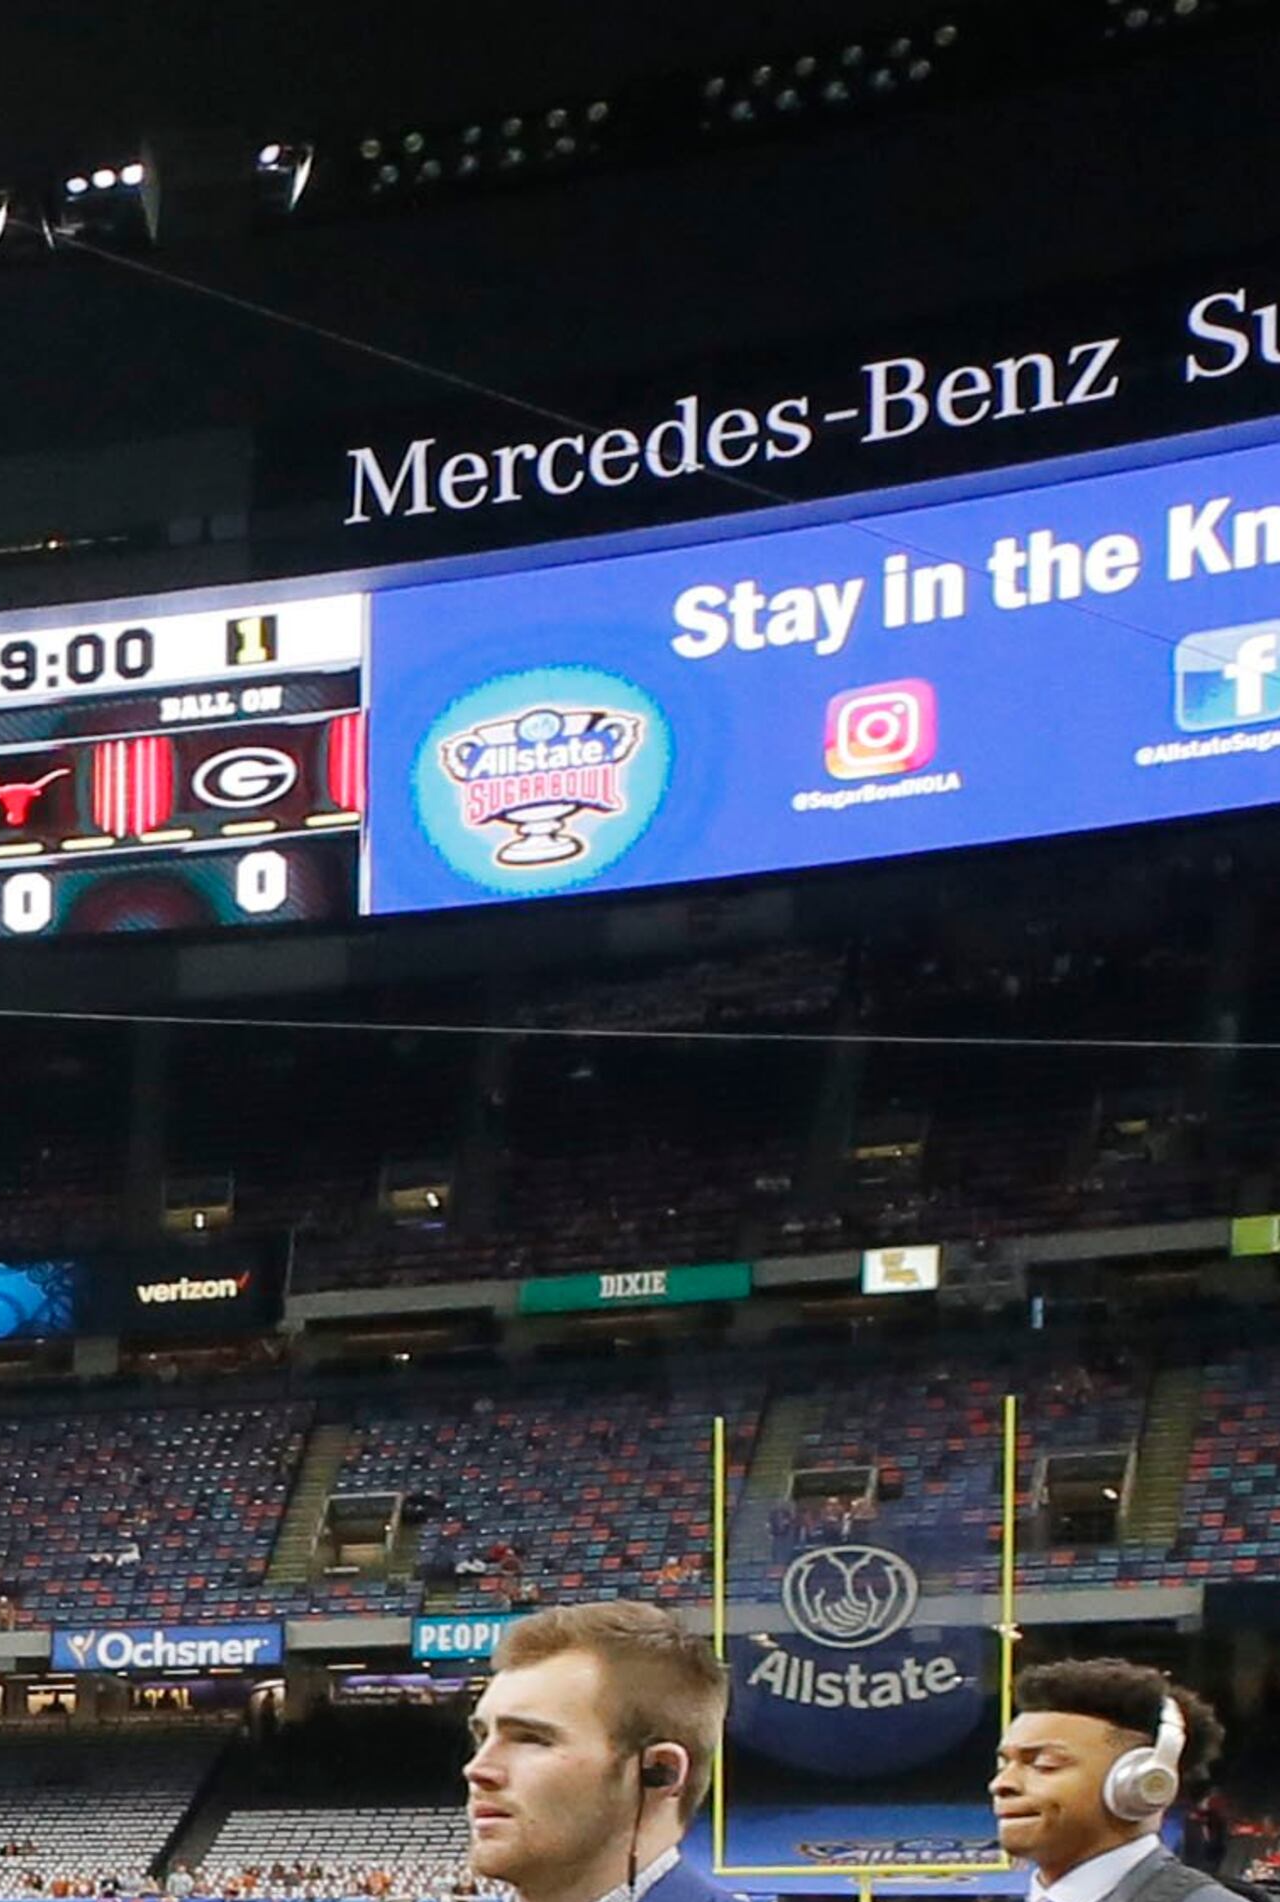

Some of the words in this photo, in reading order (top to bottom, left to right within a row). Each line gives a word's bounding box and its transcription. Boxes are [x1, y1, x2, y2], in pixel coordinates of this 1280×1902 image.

[343, 338, 1122, 526] Mercedes-Benz
[671, 576, 863, 660] Stay
[883, 552, 964, 630] in
[988, 527, 1141, 612] the
[235, 617, 269, 666] 1
[2, 871, 52, 934] 0
[236, 849, 288, 914] 0
[137, 1277, 238, 1304] verizon
[599, 1270, 668, 1299] DIXIE
[96, 1630, 261, 1669] Ochsner
[747, 1650, 958, 1709] Allstate
